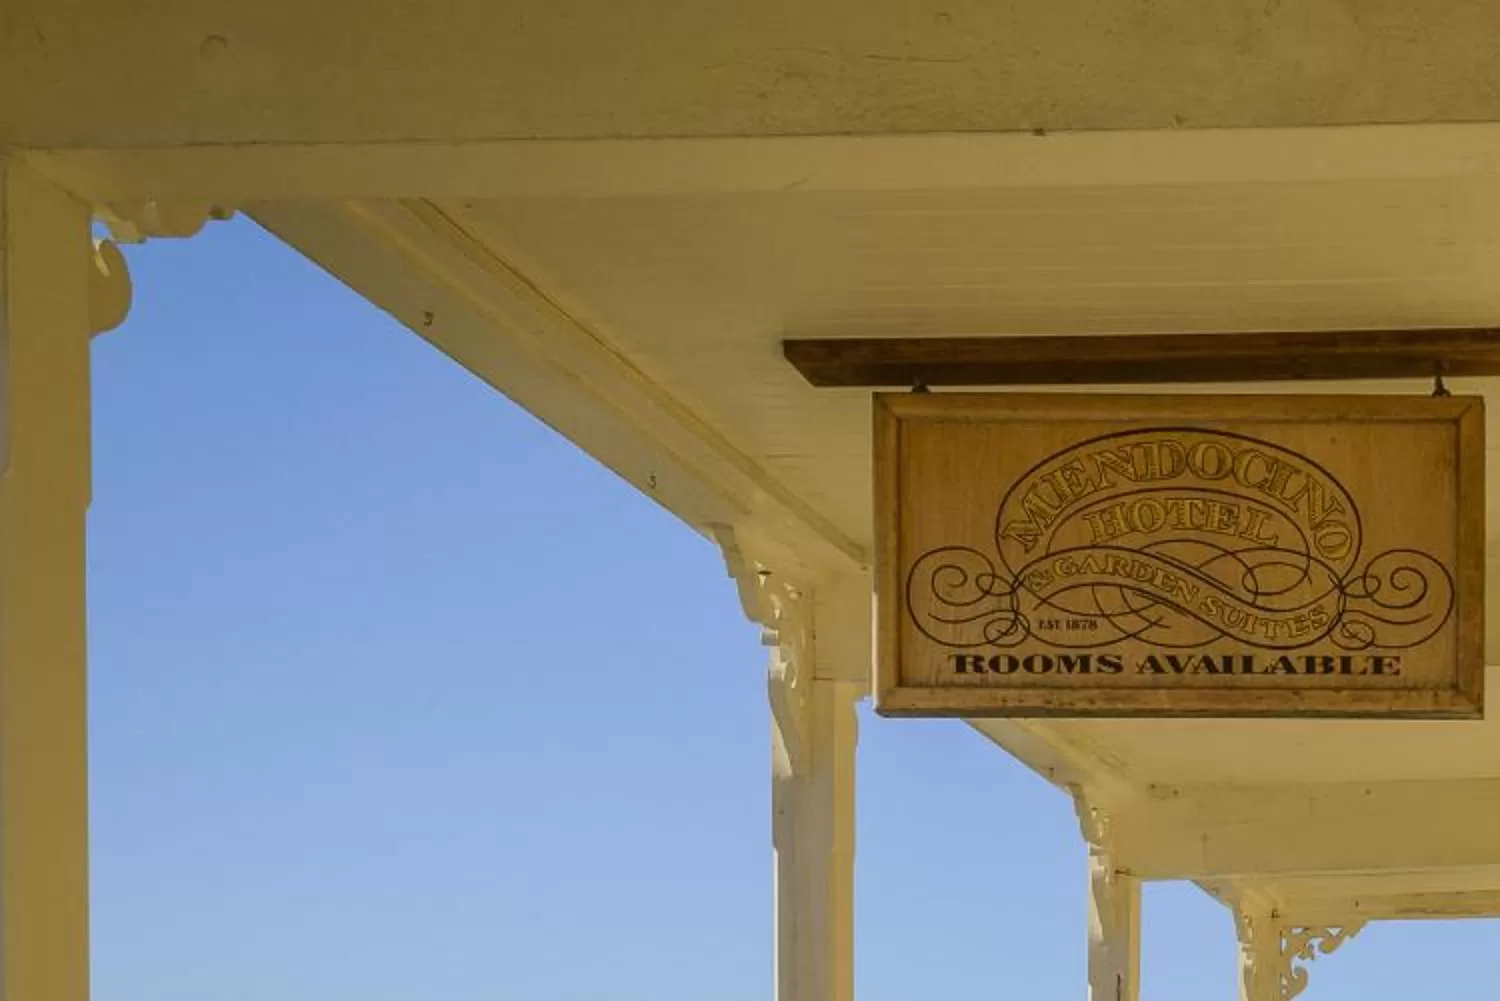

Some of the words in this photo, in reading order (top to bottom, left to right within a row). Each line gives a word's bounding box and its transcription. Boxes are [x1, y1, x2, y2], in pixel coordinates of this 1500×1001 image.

[1001, 441, 1353, 560] MENDOCINO
[1083, 496, 1279, 546] HOTEL
[1052, 554, 1202, 602] GARDEN
[1200, 596, 1330, 640] SUITES
[949, 654, 1124, 674] ROOMS
[1136, 654, 1401, 675] AVAILABLE
